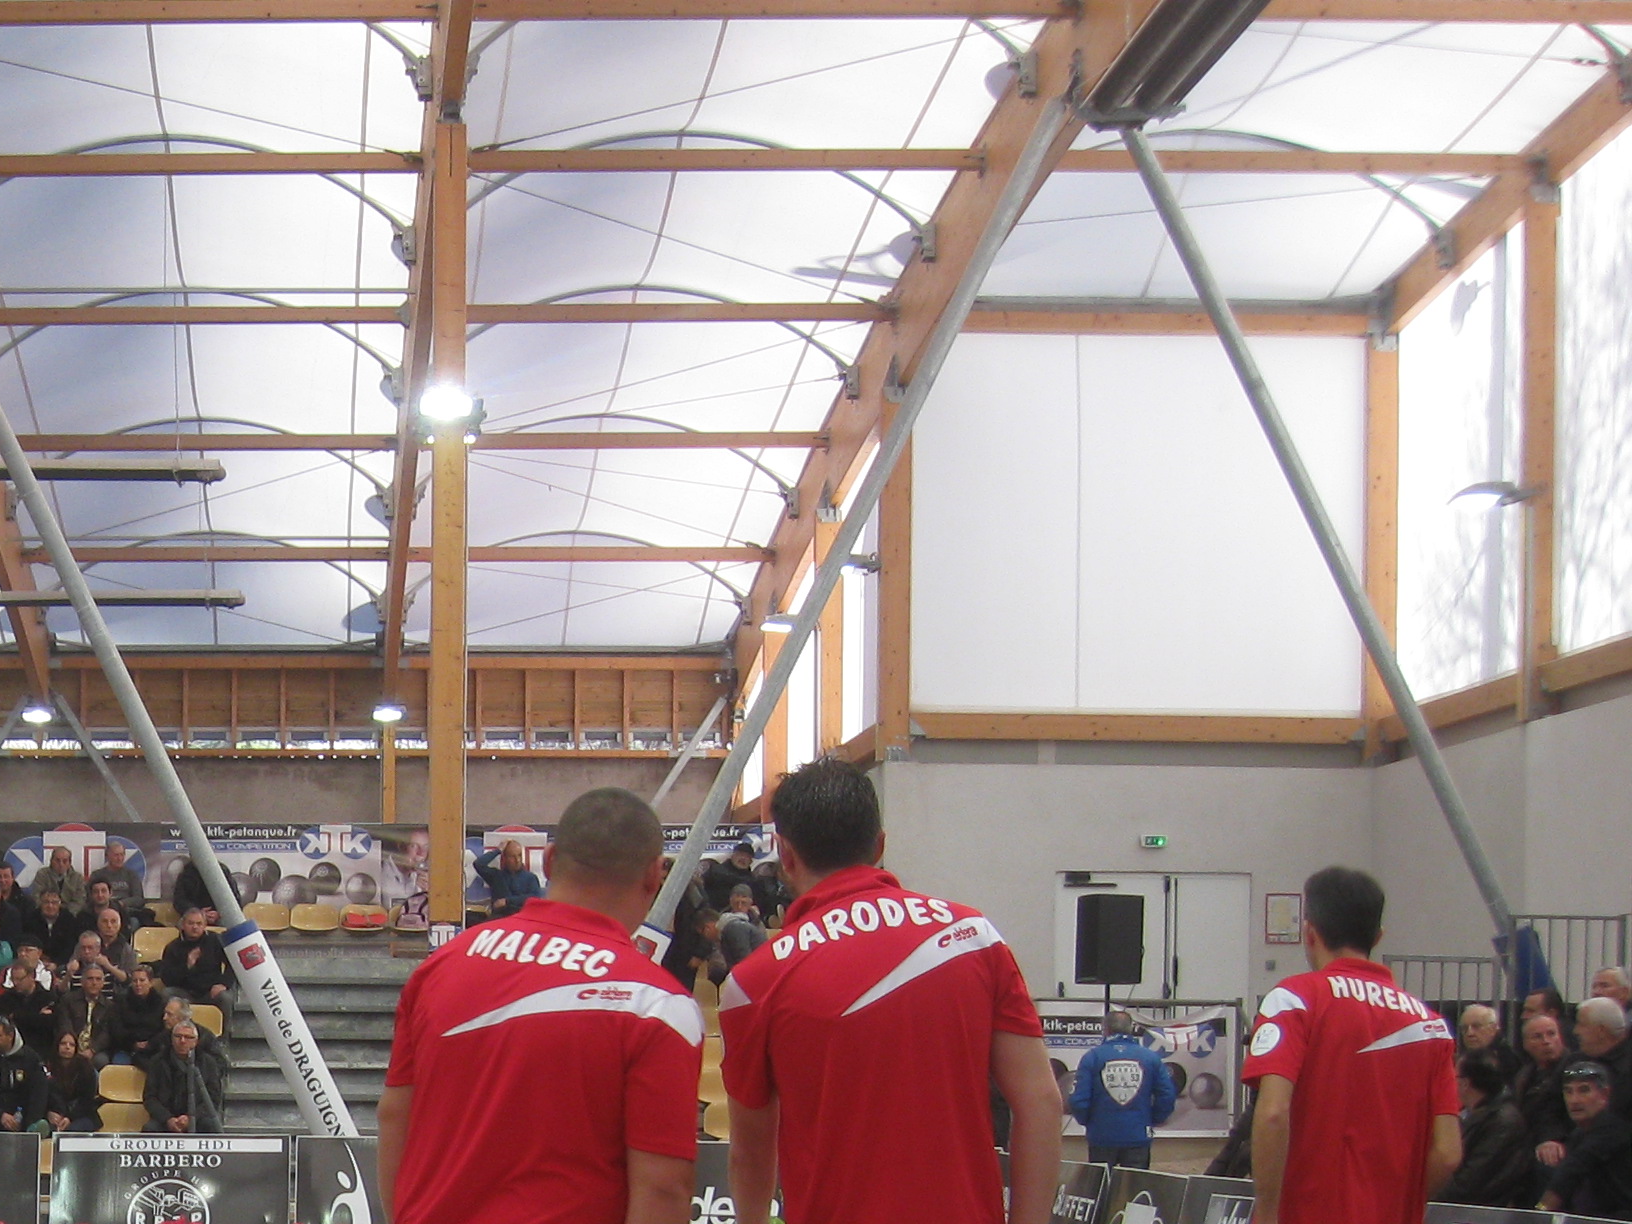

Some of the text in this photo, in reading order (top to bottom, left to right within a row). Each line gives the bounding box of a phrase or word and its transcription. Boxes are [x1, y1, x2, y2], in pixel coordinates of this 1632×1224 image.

[170, 826, 298, 838] wktk-petanque.fr
[302, 825, 367, 856] KTK
[771, 897, 955, 961] DARODES
[466, 929, 616, 979] MALBEC
[1327, 975, 1429, 1019] HUREAU
[259, 977, 347, 1137] Ville de DRAGUIGN
[110, 1140, 233, 1151] GROUPE HDI
[120, 1154, 222, 1168] BARBERO
